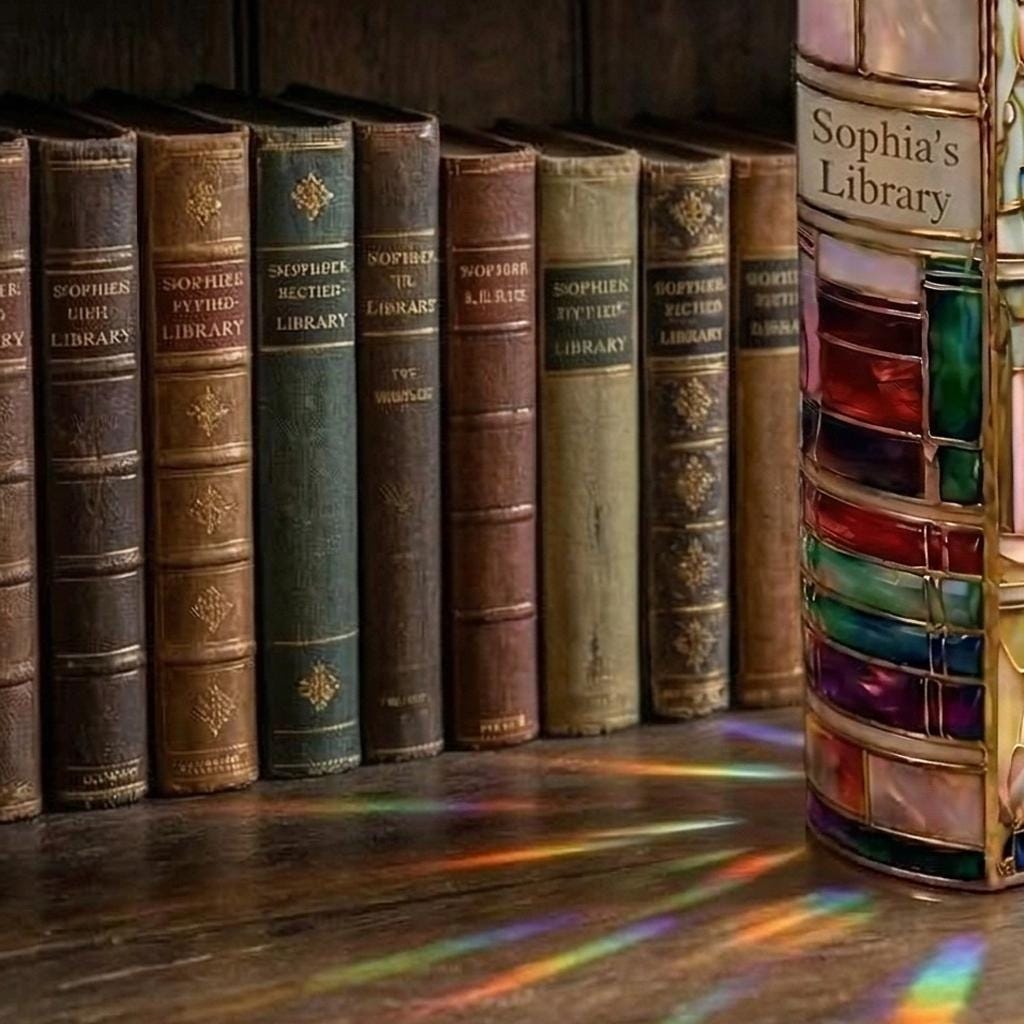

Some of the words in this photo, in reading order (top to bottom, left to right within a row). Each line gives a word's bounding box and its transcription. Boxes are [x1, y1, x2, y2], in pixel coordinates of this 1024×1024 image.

[812, 107, 960, 167] Sophia's
[820, 159, 952, 224] Library
[162, 319, 245, 340] LIBRARY
[276, 312, 348, 331] LIBRARY
[51, 329, 130, 348] LIBRARY
